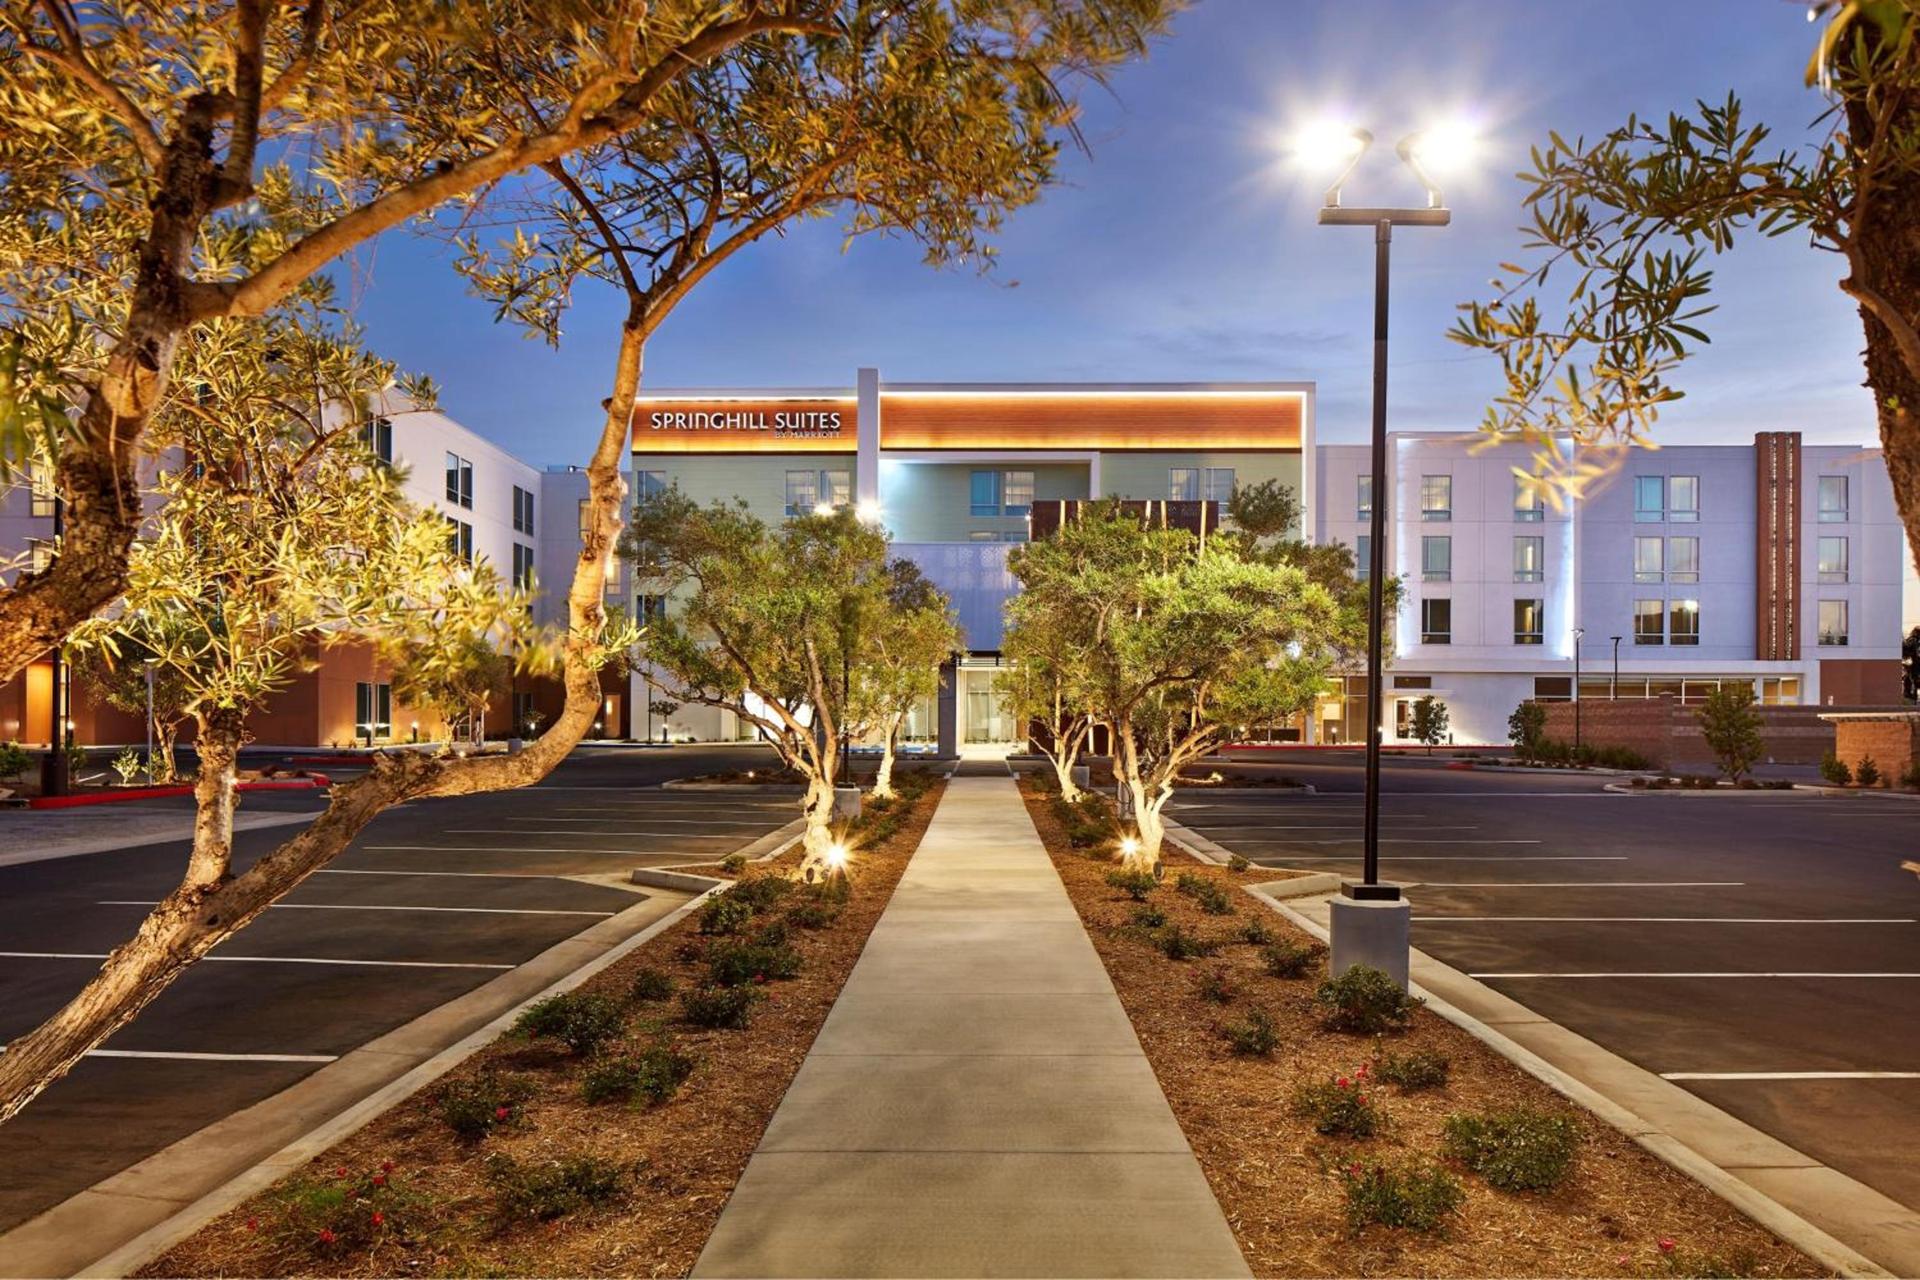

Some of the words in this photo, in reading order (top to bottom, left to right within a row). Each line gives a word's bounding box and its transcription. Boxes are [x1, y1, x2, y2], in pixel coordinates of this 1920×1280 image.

[651, 412, 769, 429] SPRINGHILL
[774, 412, 841, 429] SUITES
[775, 431, 787, 439] BY
[790, 431, 840, 439] MARRIOTT
